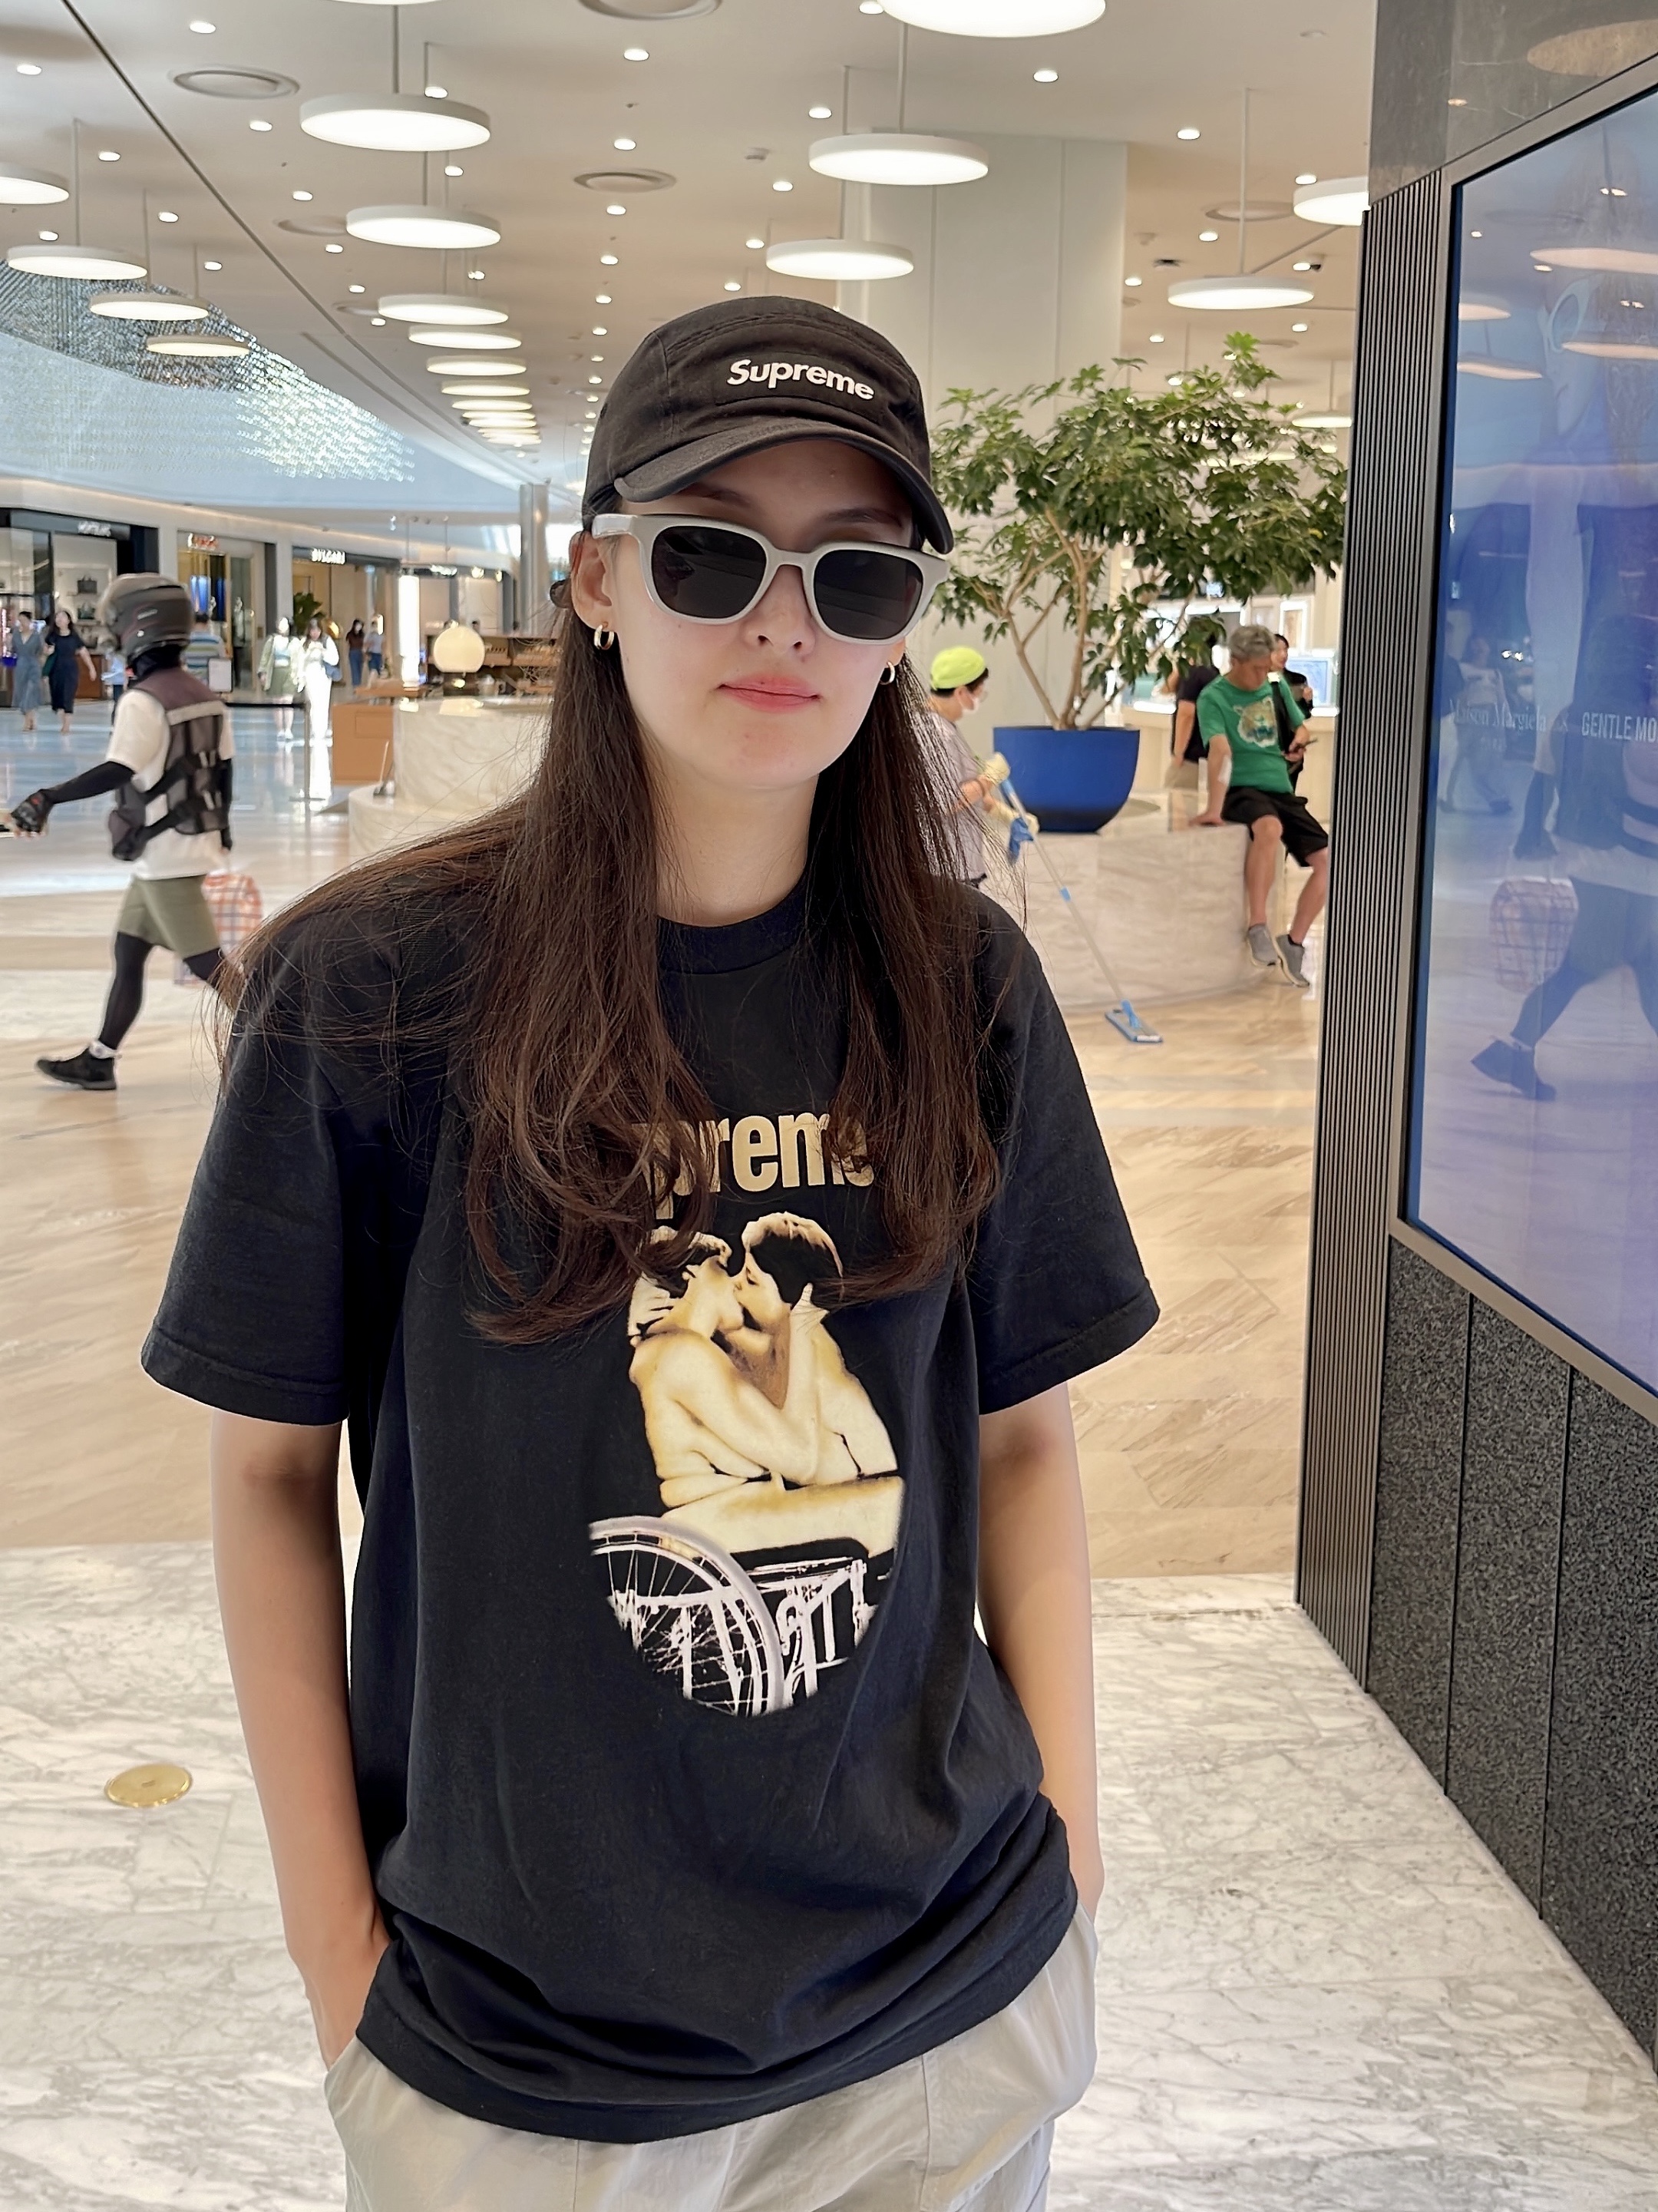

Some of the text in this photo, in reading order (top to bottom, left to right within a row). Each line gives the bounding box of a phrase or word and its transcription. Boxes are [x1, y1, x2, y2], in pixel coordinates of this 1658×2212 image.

[727, 359, 874, 400] Supreme
[1581, 711, 1633, 740] GENTLE
[1635, 716, 1658, 742] MO
[631, 1112, 874, 1220] preme
